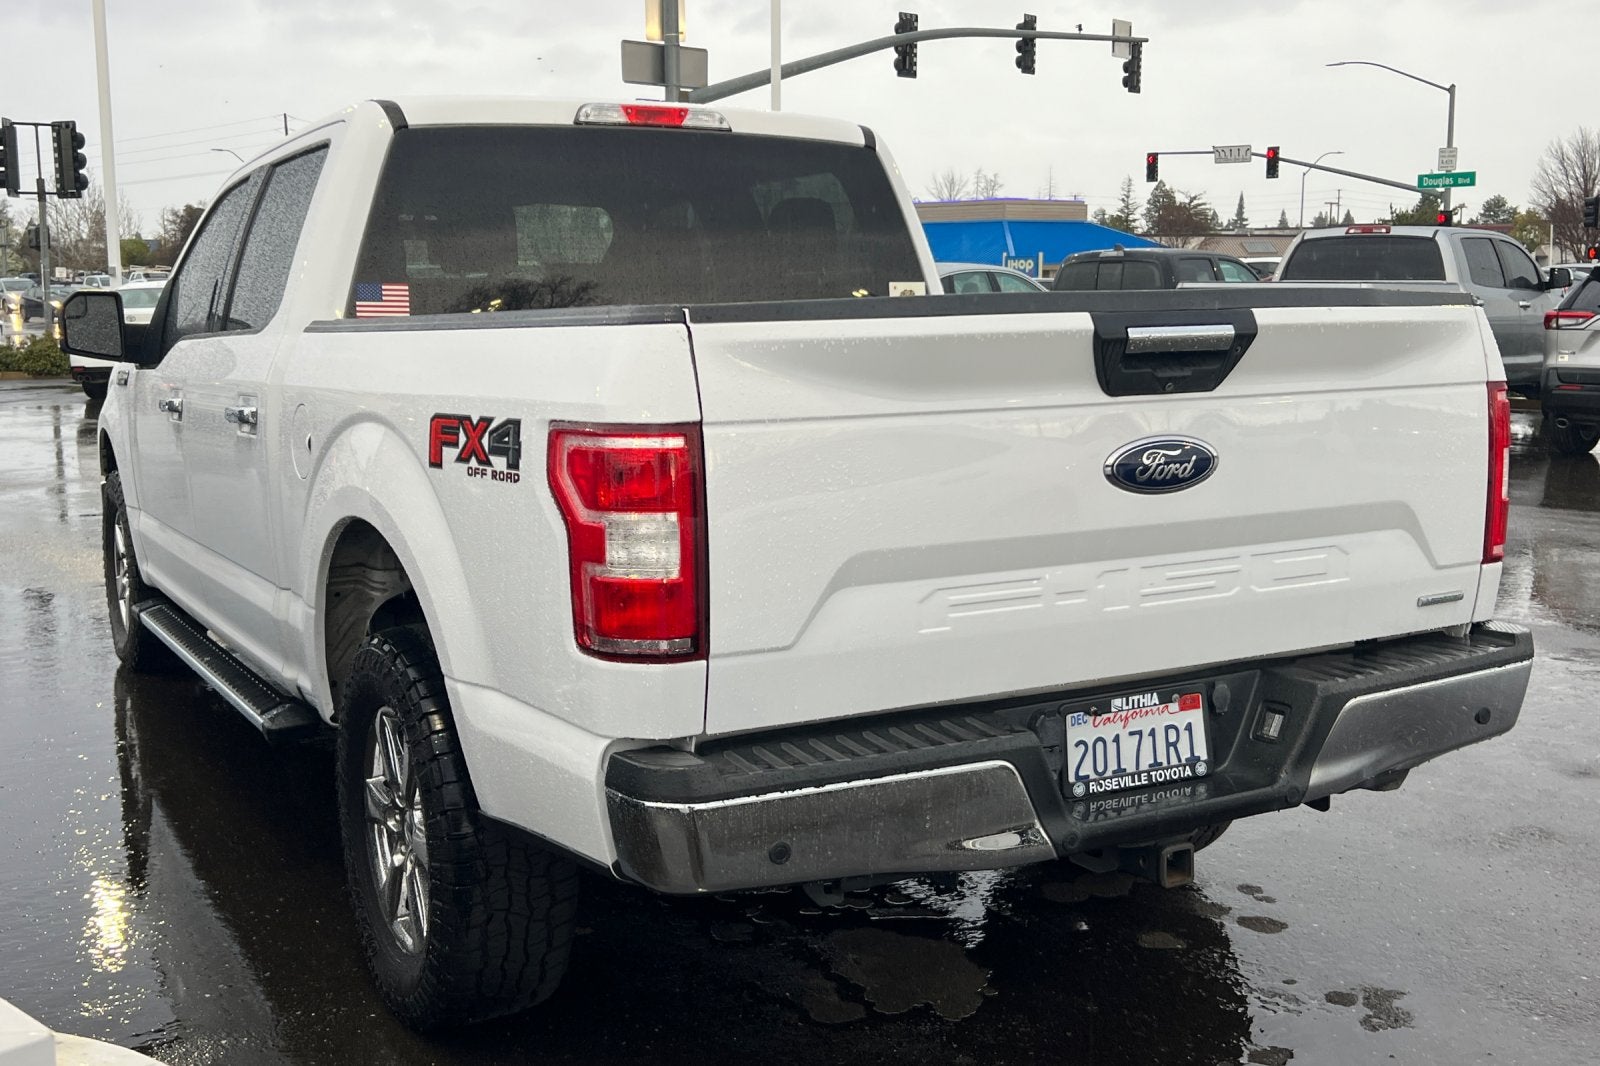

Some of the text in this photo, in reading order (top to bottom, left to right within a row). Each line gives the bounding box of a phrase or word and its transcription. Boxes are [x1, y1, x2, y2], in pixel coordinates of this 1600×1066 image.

[1423, 177, 1454, 187] Douglas
[429, 413, 521, 470] FX4
[467, 466, 520, 483] OFF ROAD
[1135, 448, 1197, 481] Ford
[1122, 692, 1159, 710] LITHIA
[1070, 713, 1088, 727] DEC
[1092, 703, 1180, 729] California
[1074, 721, 1201, 782] 20171R1
[1089, 766, 1192, 793] ROSEVILLE TOYOTA
